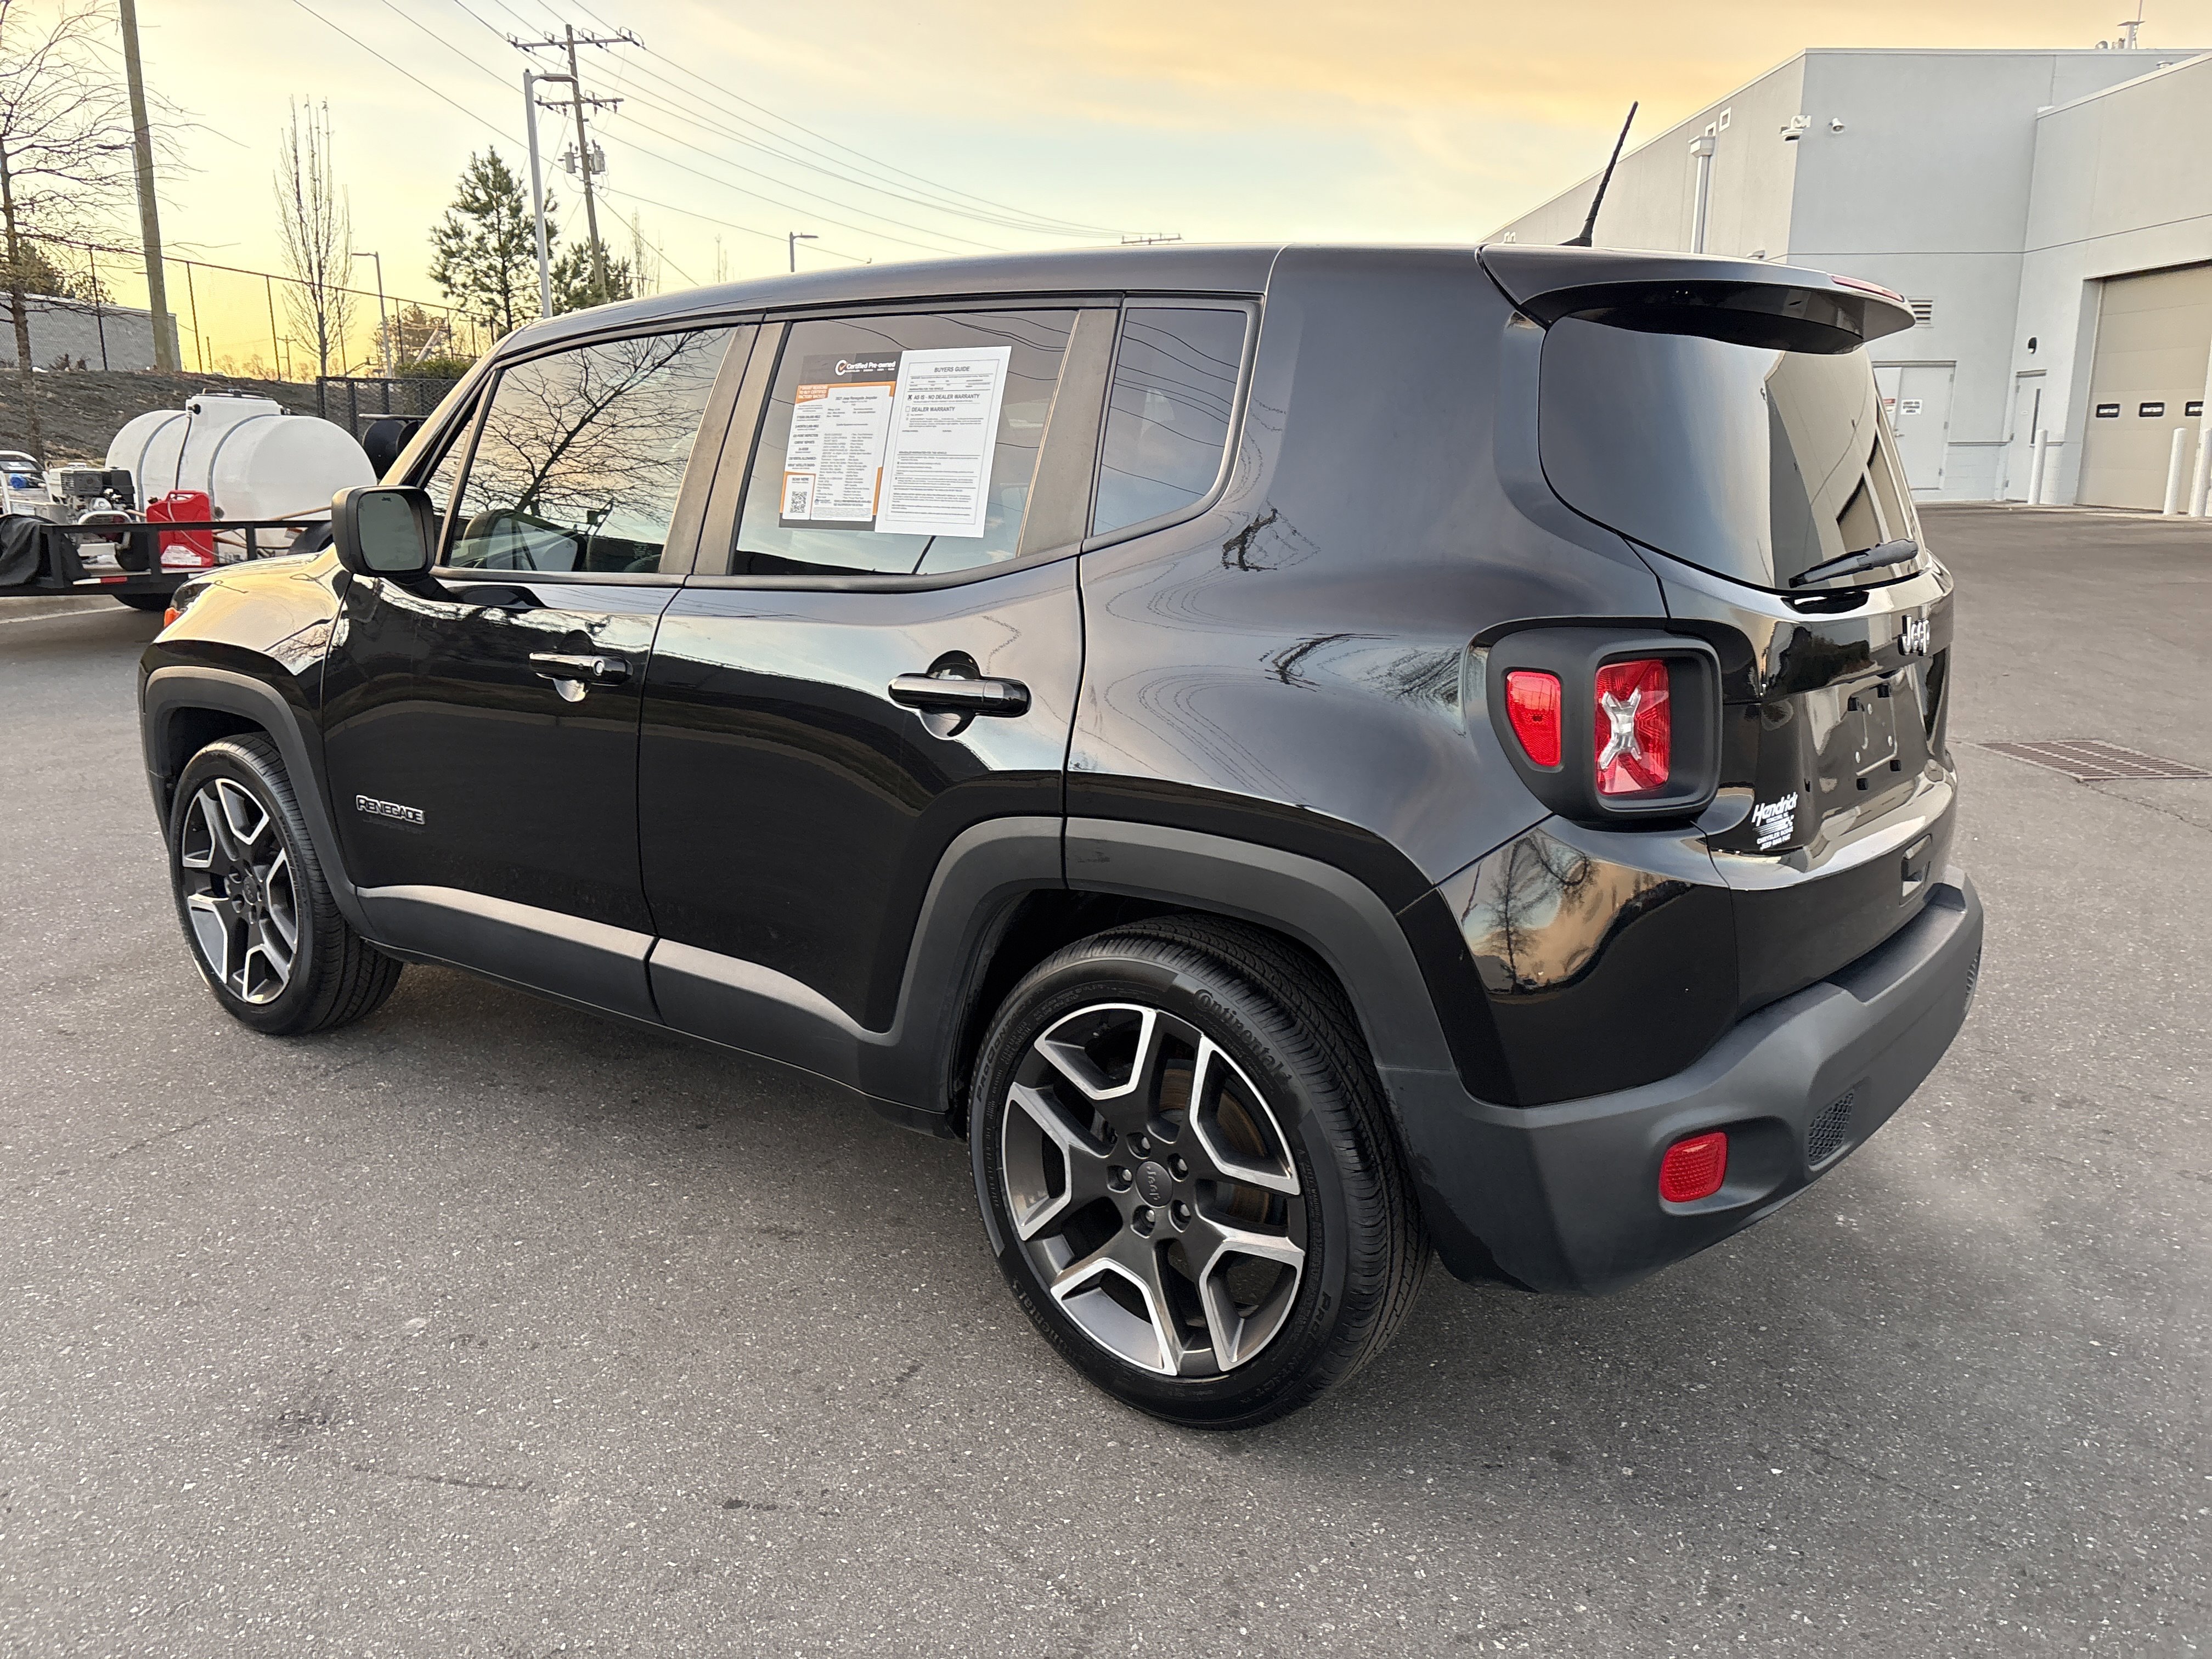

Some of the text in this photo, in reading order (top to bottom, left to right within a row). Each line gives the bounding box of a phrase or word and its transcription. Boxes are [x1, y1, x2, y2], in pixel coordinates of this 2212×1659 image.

[356, 795, 425, 825] RENEGADE
[1751, 792, 1798, 827] Hendrick
[1193, 989, 1284, 1077] Continental
[1146, 1166, 1161, 1200] Jeep
